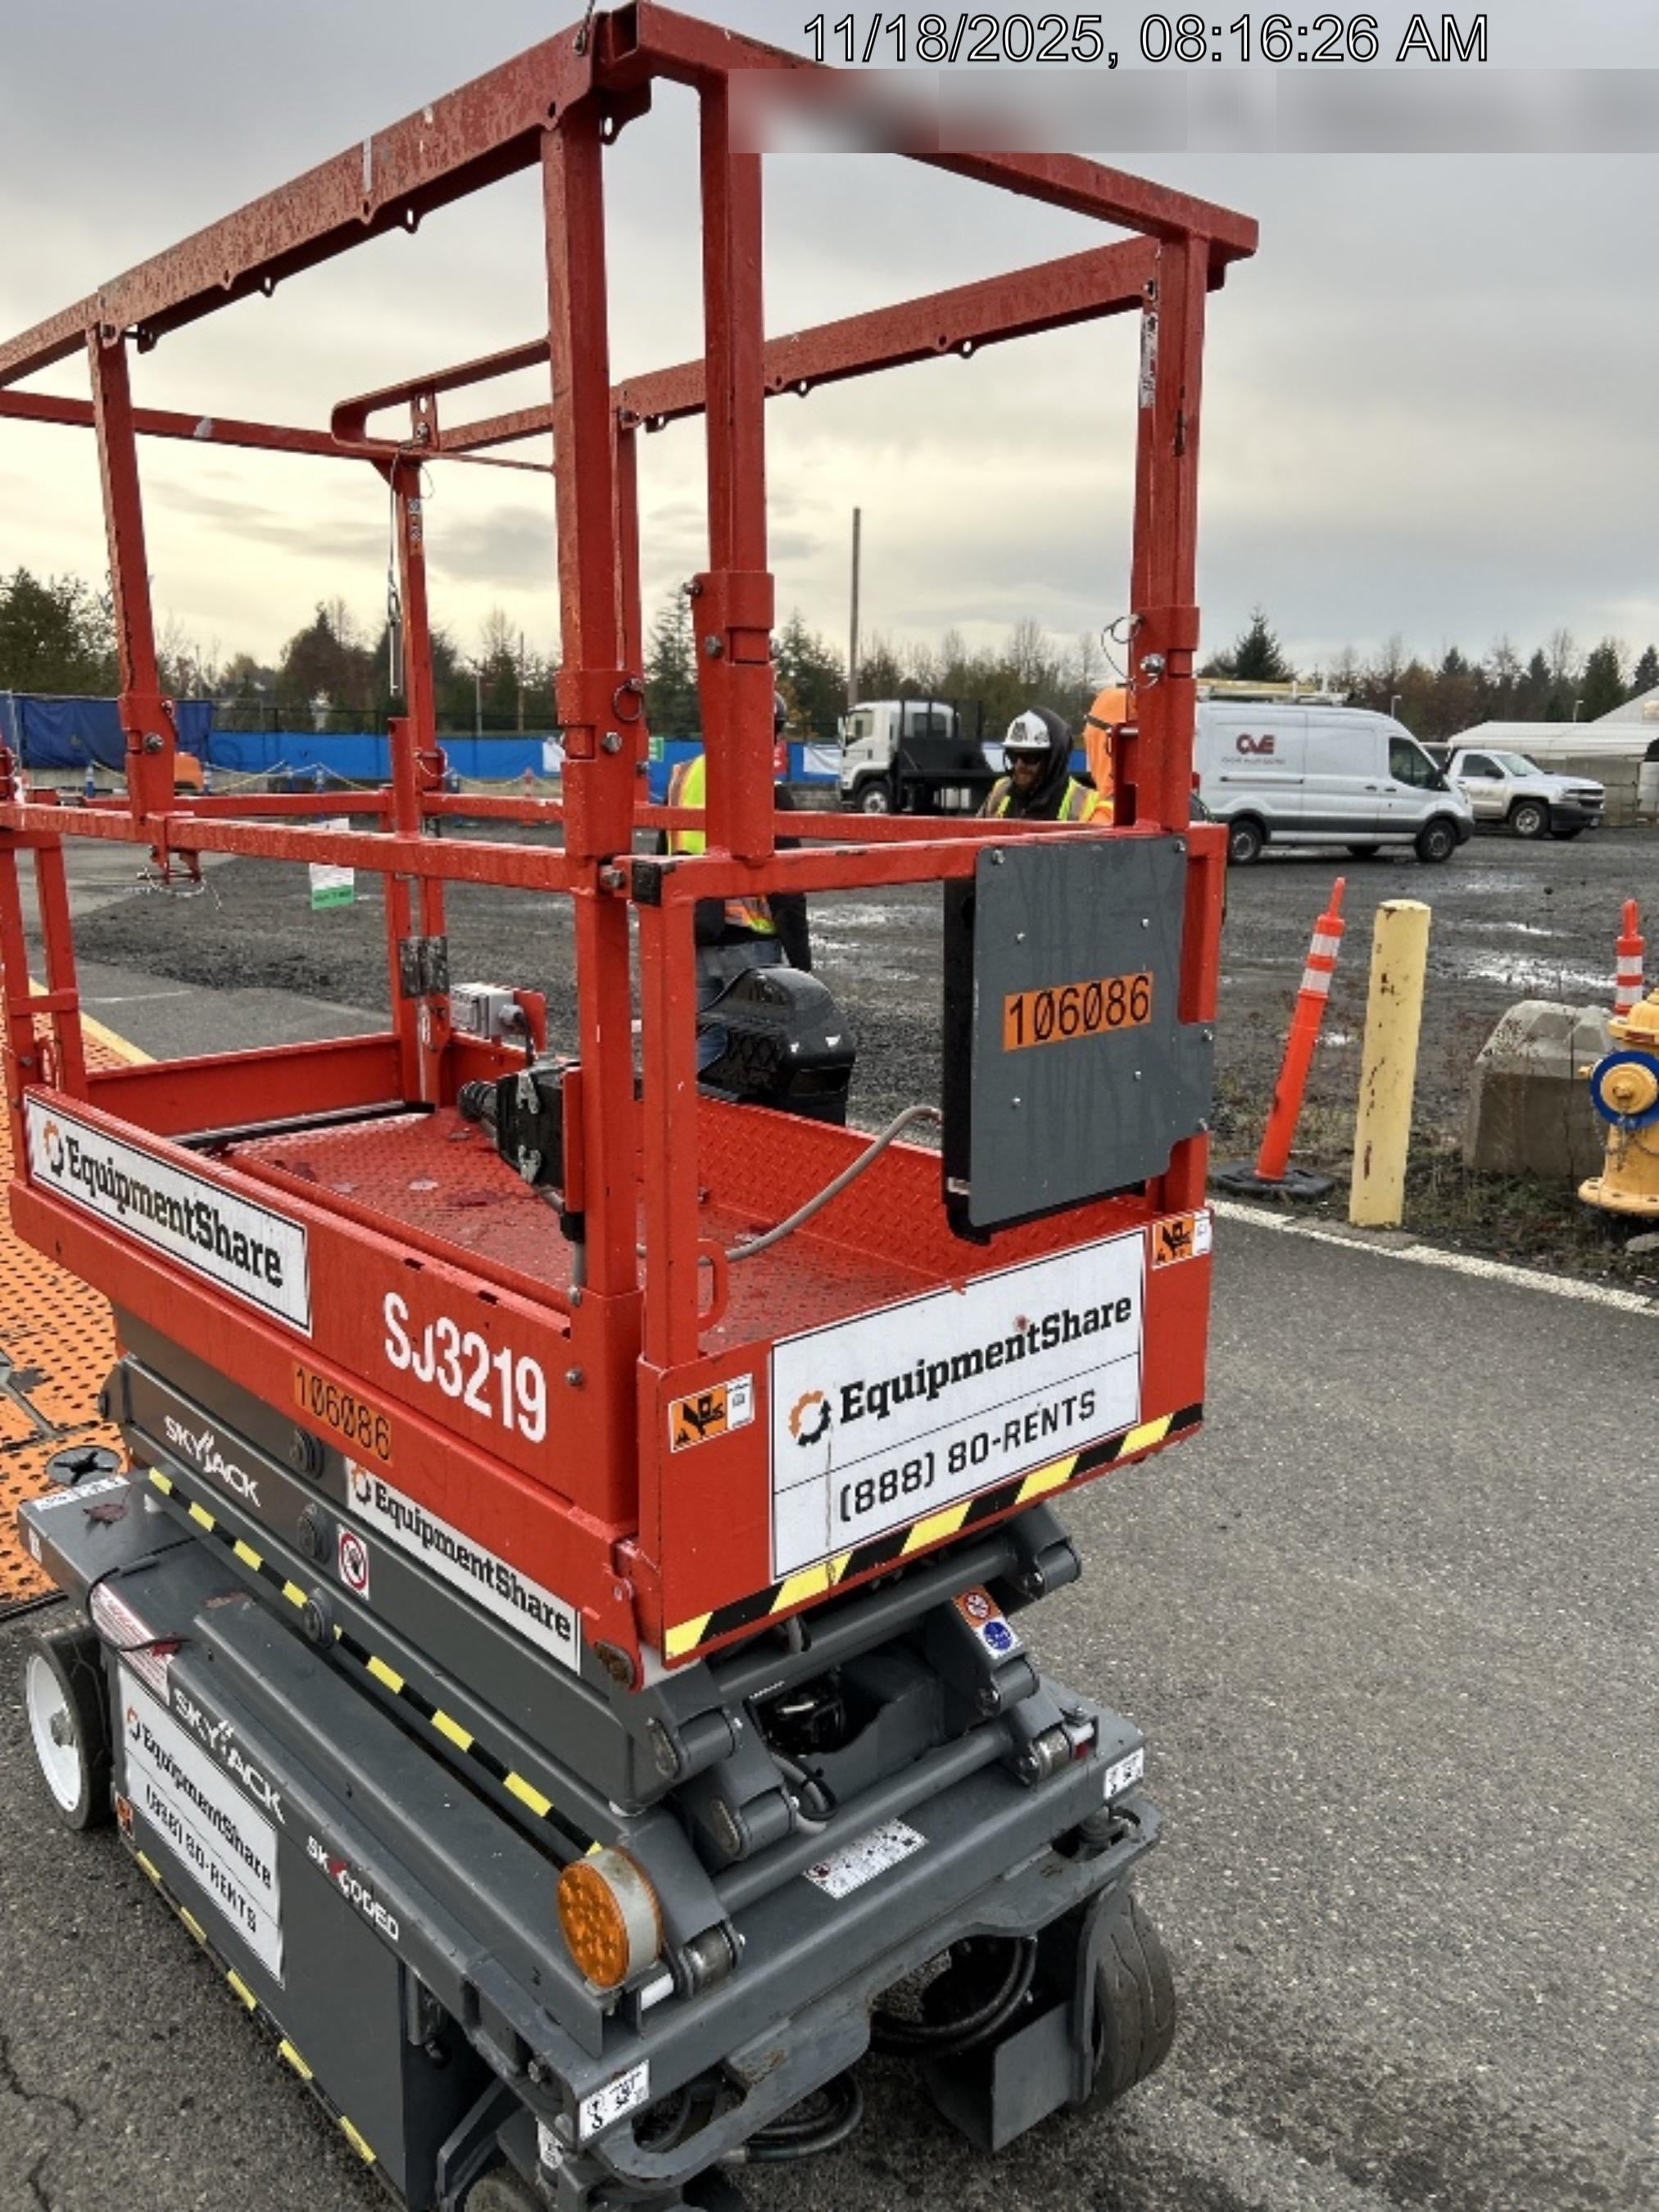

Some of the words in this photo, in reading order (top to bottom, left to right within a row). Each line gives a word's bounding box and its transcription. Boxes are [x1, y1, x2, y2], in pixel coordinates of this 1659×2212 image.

[1010, 976, 1149, 1045] 106086
[66, 1135, 283, 1288] EquipmentShare
[297, 1367, 391, 1461] 106086
[383, 1292, 546, 1443] SJ3219
[839, 1297, 1131, 1424] EquipmentShare
[165, 1415, 261, 1507] SKYJACK
[840, 1452, 935, 1521] (888)
[948, 1389, 1095, 1475] 80-RENTS
[374, 1480, 571, 1641] EquipmentShare
[143, 1722, 272, 1890] EquipmentShare
[173, 1688, 286, 1824] SKYJACK
